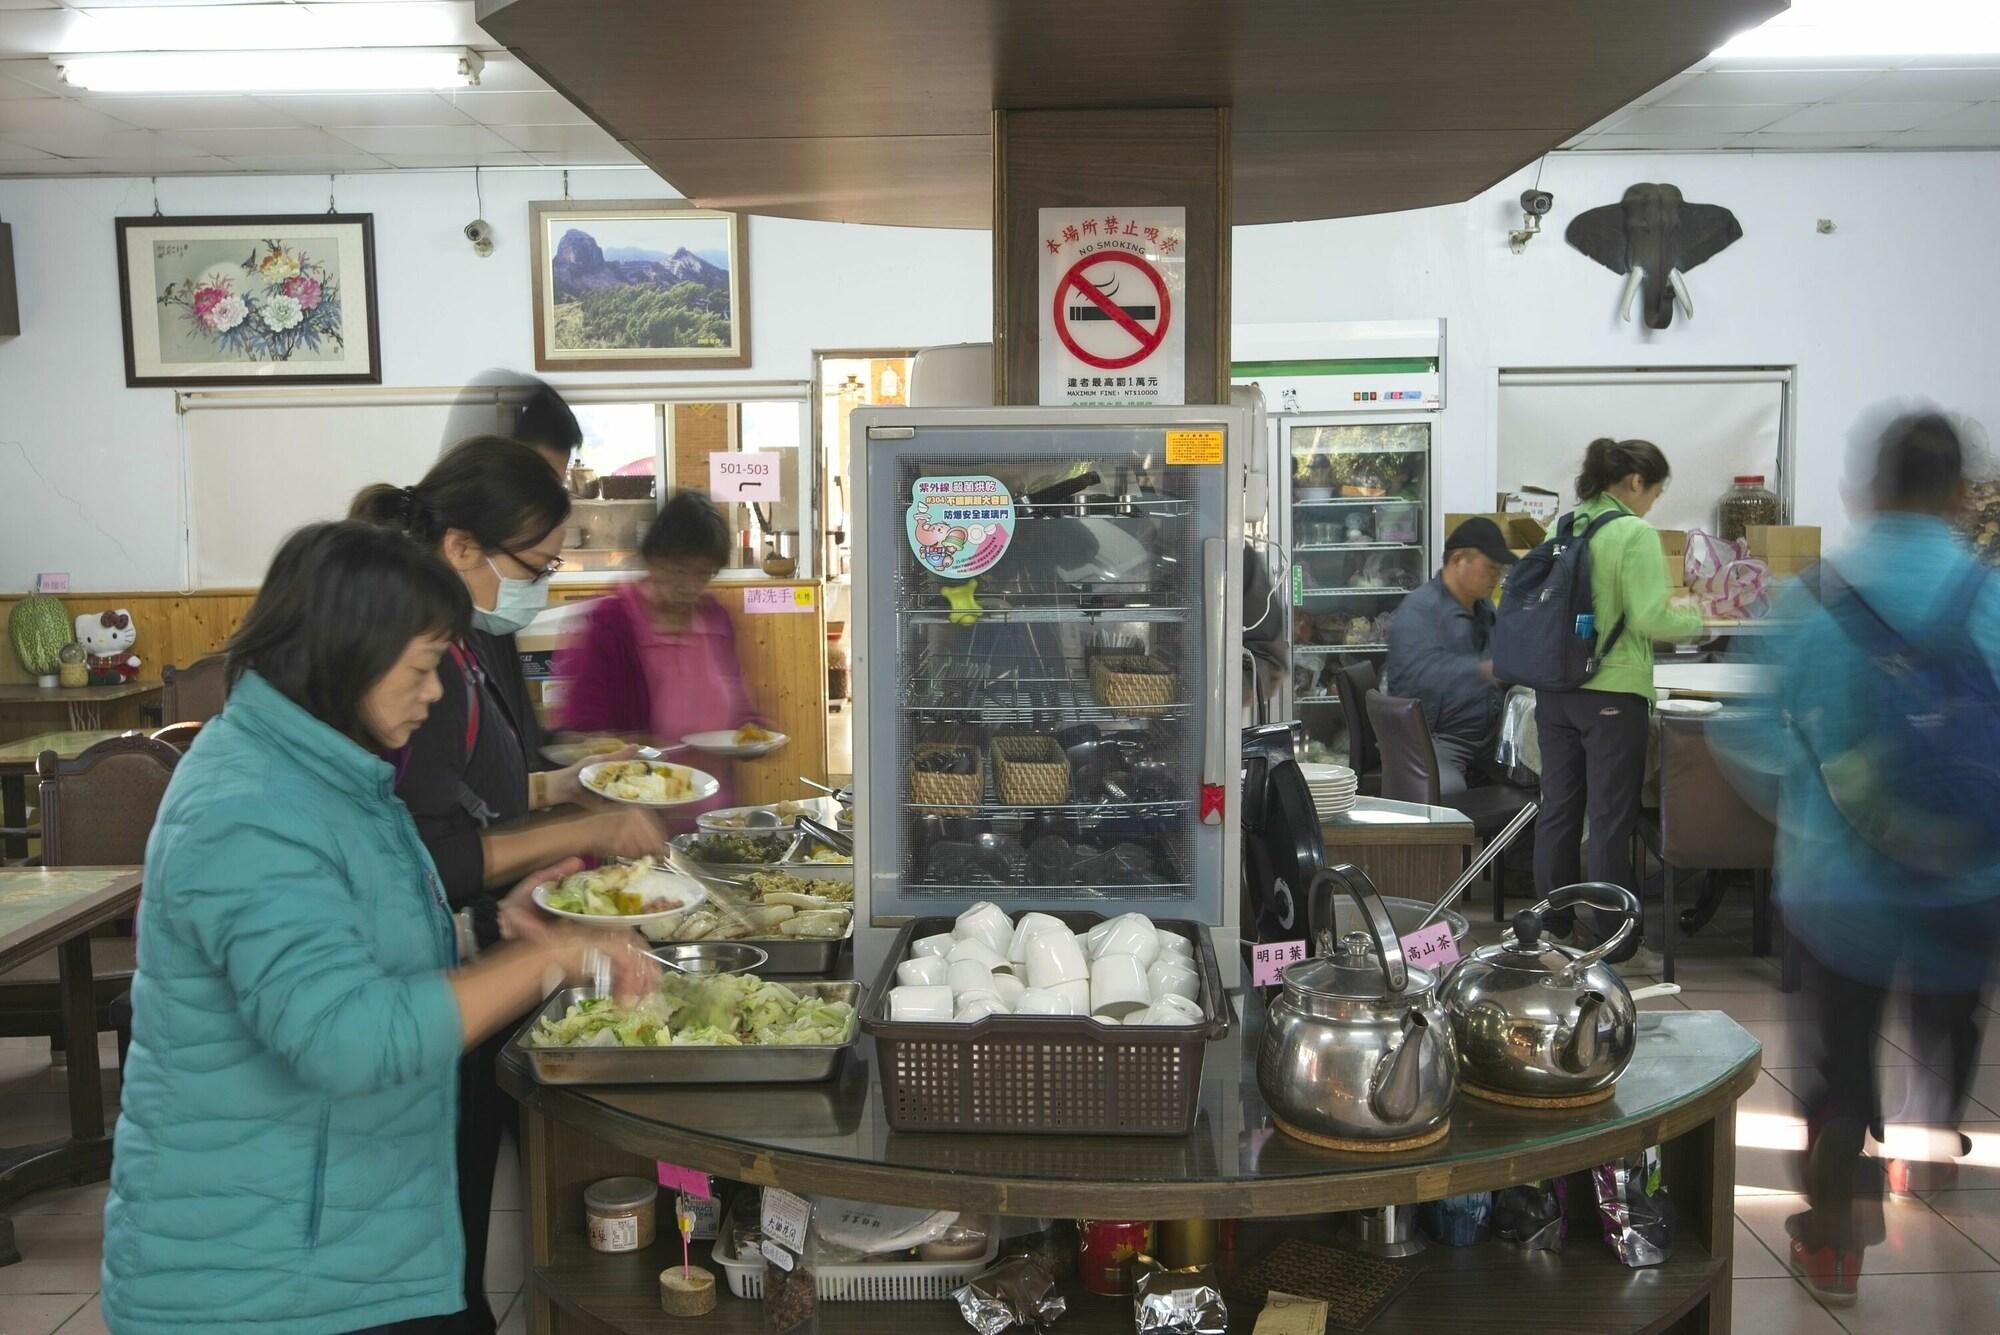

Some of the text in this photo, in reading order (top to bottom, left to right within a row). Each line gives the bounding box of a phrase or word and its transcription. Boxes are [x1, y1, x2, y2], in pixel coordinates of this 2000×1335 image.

[1079, 240, 1146, 256] NO SMOKING
[720, 463, 769, 475] 501-503
[747, 588, 793, 604] 請洗手
[1256, 945, 1302, 963] 明日葉
[1408, 934, 1451, 961] 高山茶
